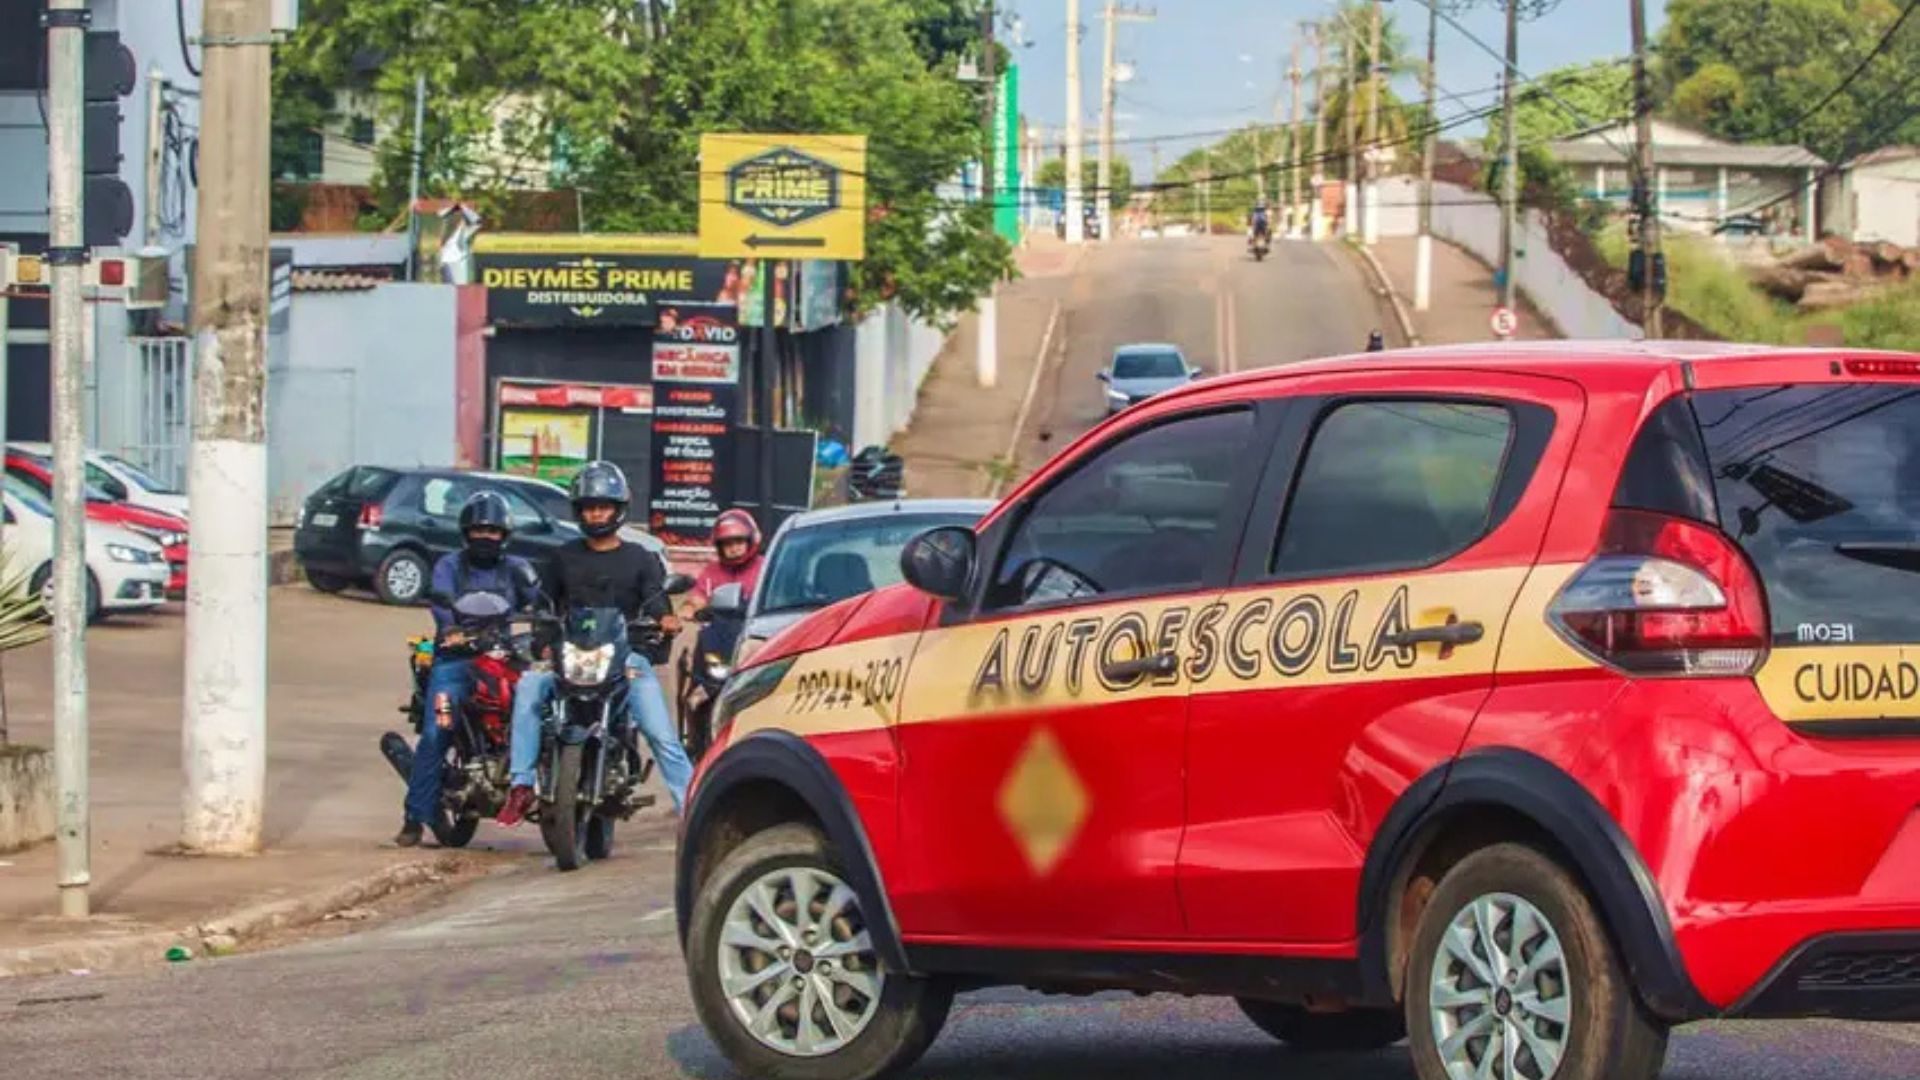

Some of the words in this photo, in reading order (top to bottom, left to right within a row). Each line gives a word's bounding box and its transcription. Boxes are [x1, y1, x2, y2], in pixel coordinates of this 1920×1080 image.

[735, 179, 829, 204] PRIME
[483, 268, 600, 288] DIEYMES
[607, 270, 693, 290] PRIME
[526, 291, 648, 305] DISTRIBUIDORA
[655, 404, 727, 418] SUSPENSÃO
[1797, 623, 1853, 641] MOBI
[967, 584, 1417, 706] AUTOESCOLA
